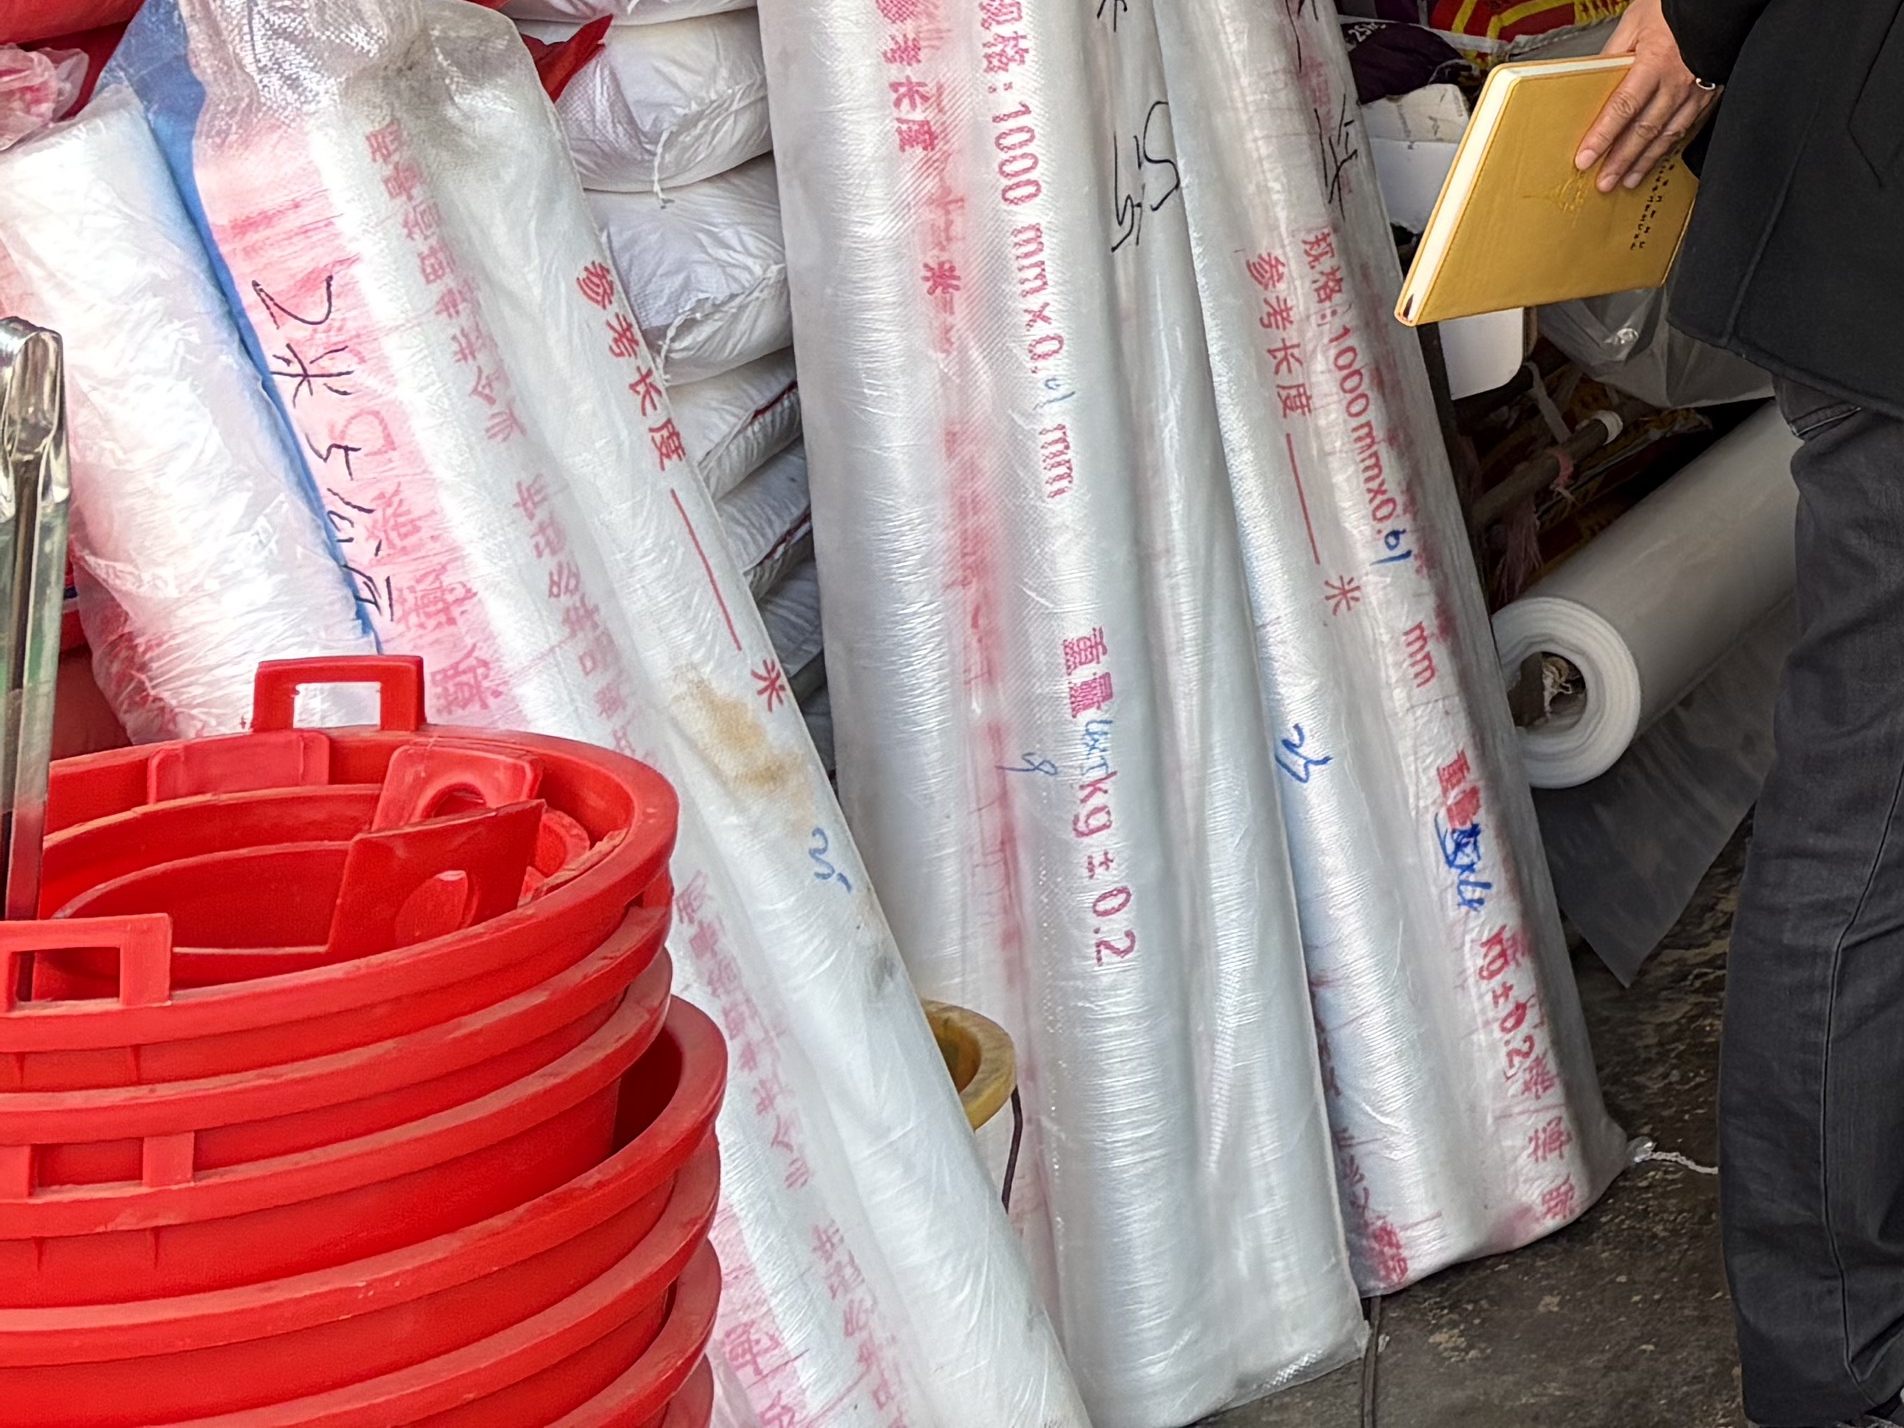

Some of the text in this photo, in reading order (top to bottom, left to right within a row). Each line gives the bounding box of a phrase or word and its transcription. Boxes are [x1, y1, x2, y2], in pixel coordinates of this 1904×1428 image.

[575, 260, 787, 712] 参考长度 米
[1244, 252, 1363, 615] 参考长度 米
[1061, 626, 1114, 721] 重量
